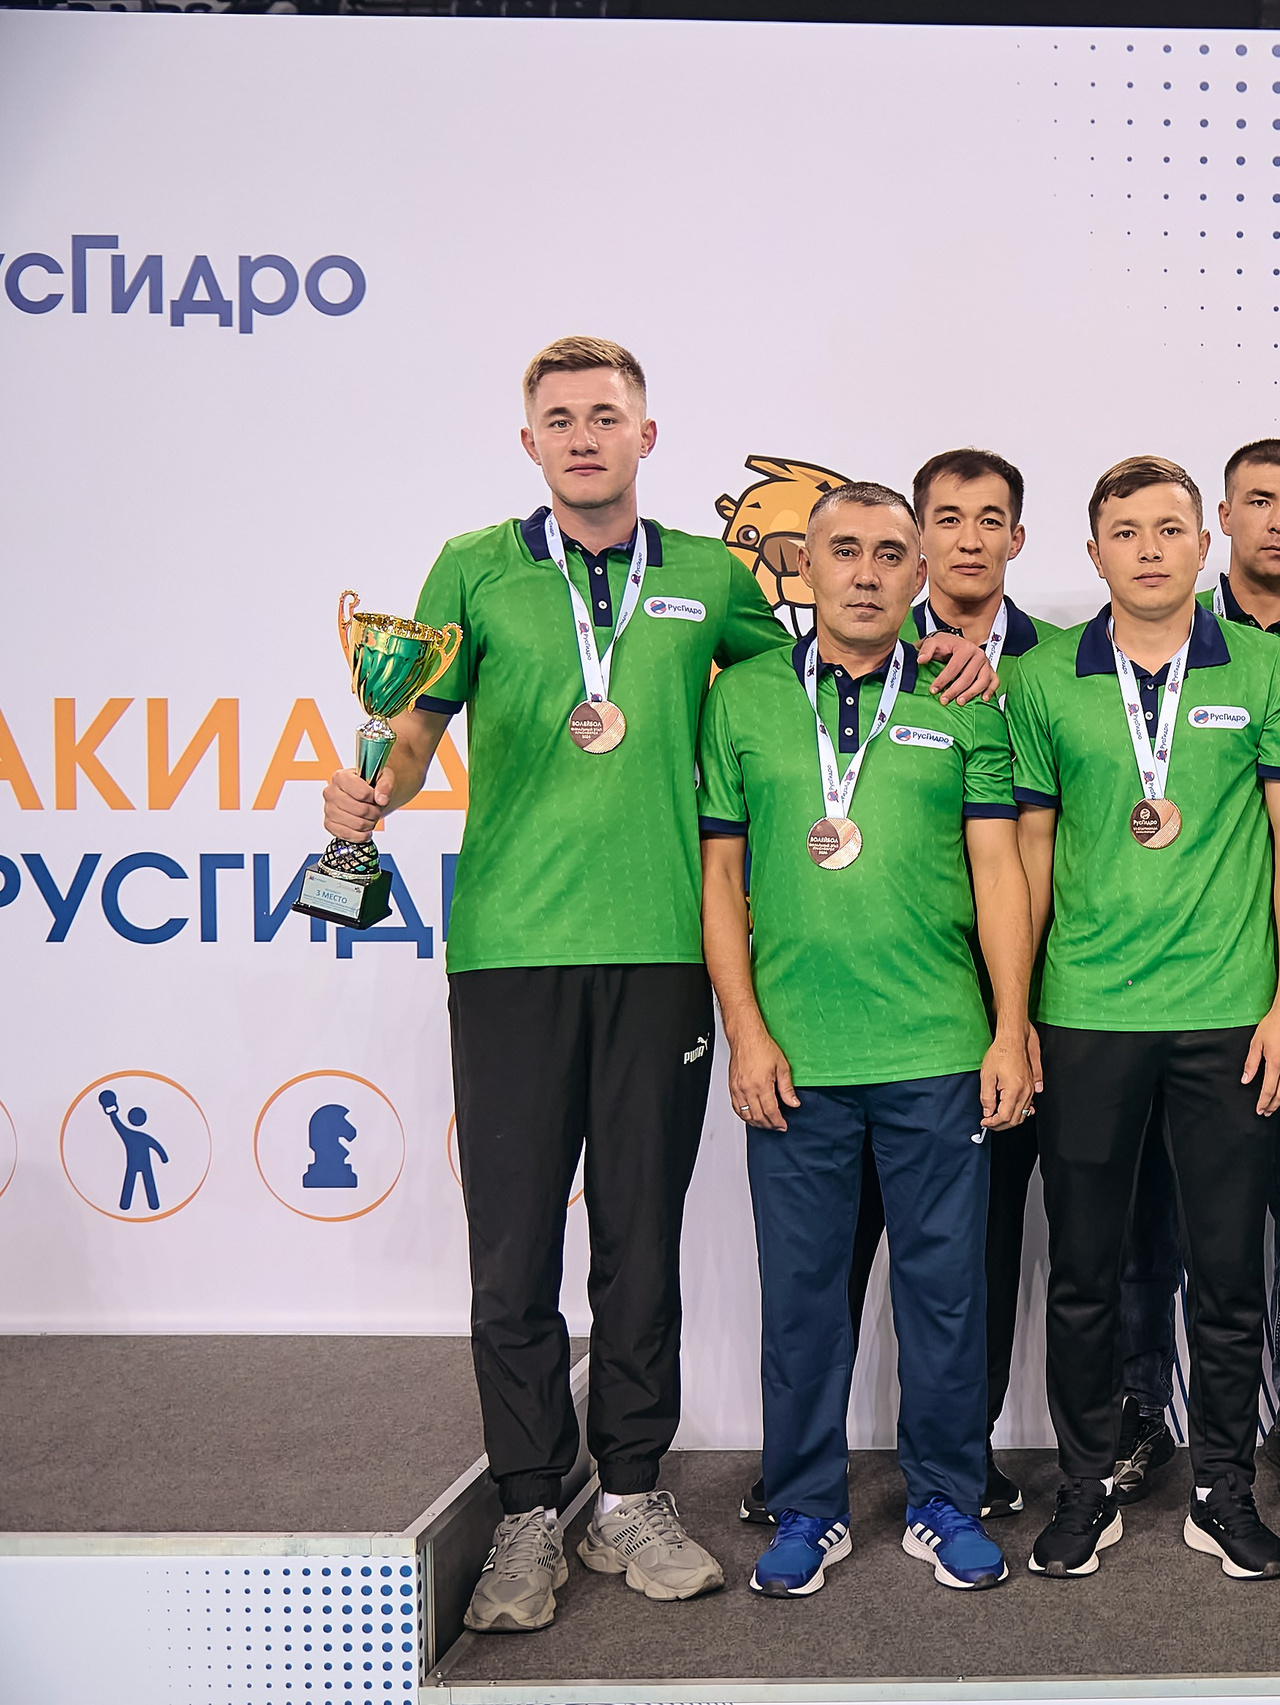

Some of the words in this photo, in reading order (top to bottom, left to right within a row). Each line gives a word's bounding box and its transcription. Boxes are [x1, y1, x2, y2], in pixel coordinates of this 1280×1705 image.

[0, 234, 366, 334] сГидро
[667, 603, 703, 616] РусГидро
[583, 633, 592, 661] РусГидро
[1172, 657, 1182, 682] РусГидро
[1133, 714, 1143, 740] РусГидро
[1210, 713, 1246, 723] РусГидро
[912, 731, 950, 745] РусГидро
[1160, 722, 1169, 749] РусГидро
[1132, 819, 1158, 827] РусГидро
[315, 889, 321, 897] 3
[321, 891, 348, 904] МЕСТО
